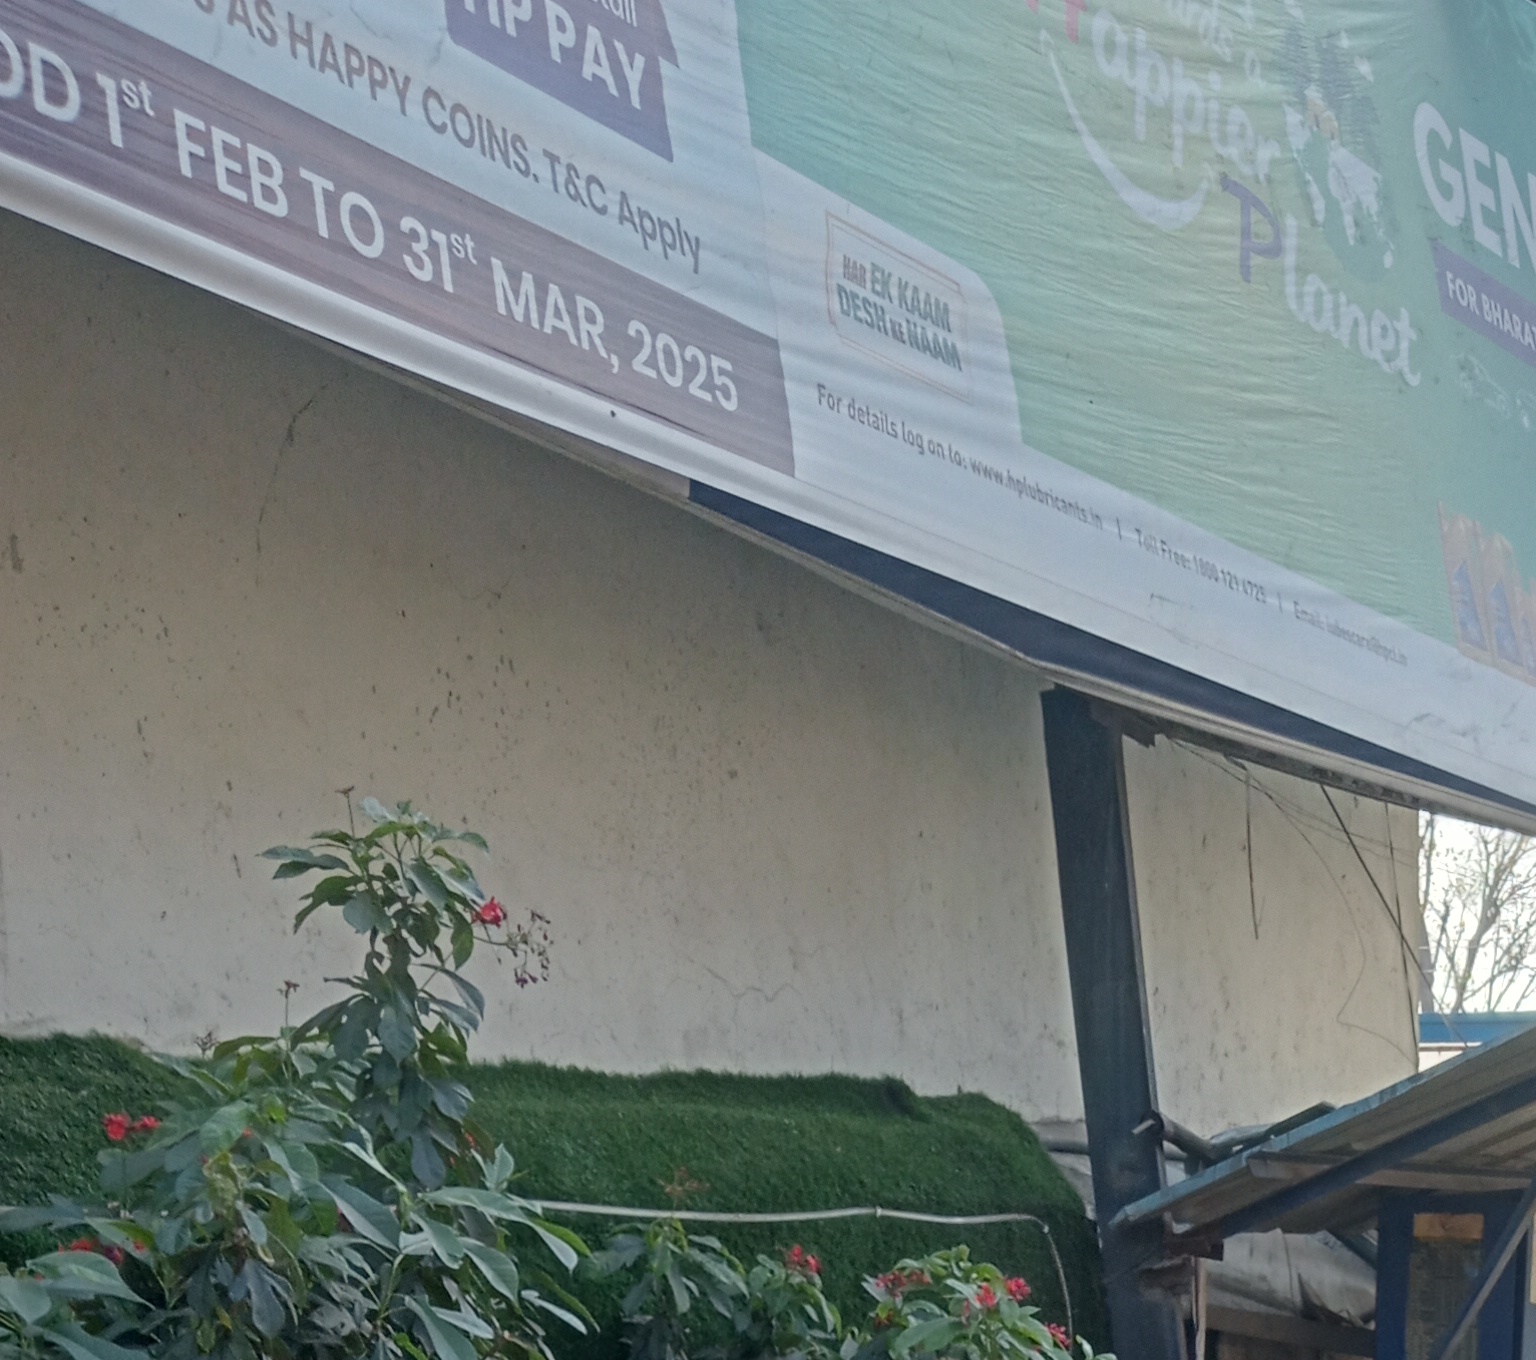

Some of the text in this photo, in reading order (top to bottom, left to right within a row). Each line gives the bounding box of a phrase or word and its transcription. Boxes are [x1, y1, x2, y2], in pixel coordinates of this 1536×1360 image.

[545, 0, 646, 111] PAY
[227, 0, 701, 275] AS HAPPY COINS. T&C Apply
[96, 72, 155, 149] 1st
[173, 108, 289, 219] FEB
[299, 167, 385, 259] TO
[400, 216, 478, 294] 31st
[491, 257, 619, 375] MAR,
[628, 320, 739, 413] 2025
[1220, 172, 1421, 387] Planet
[1446, 270, 1480, 316] FOR
[836, 282, 890, 338] DESH
[905, 317, 963, 373] NAAM
[842, 254, 953, 333] HAR EK KAAM
[817, 382, 843, 414] For
[847, 397, 899, 440] details
[902, 421, 926, 456] log
[928, 435, 946, 461] on
[949, 442, 968, 470] to:
